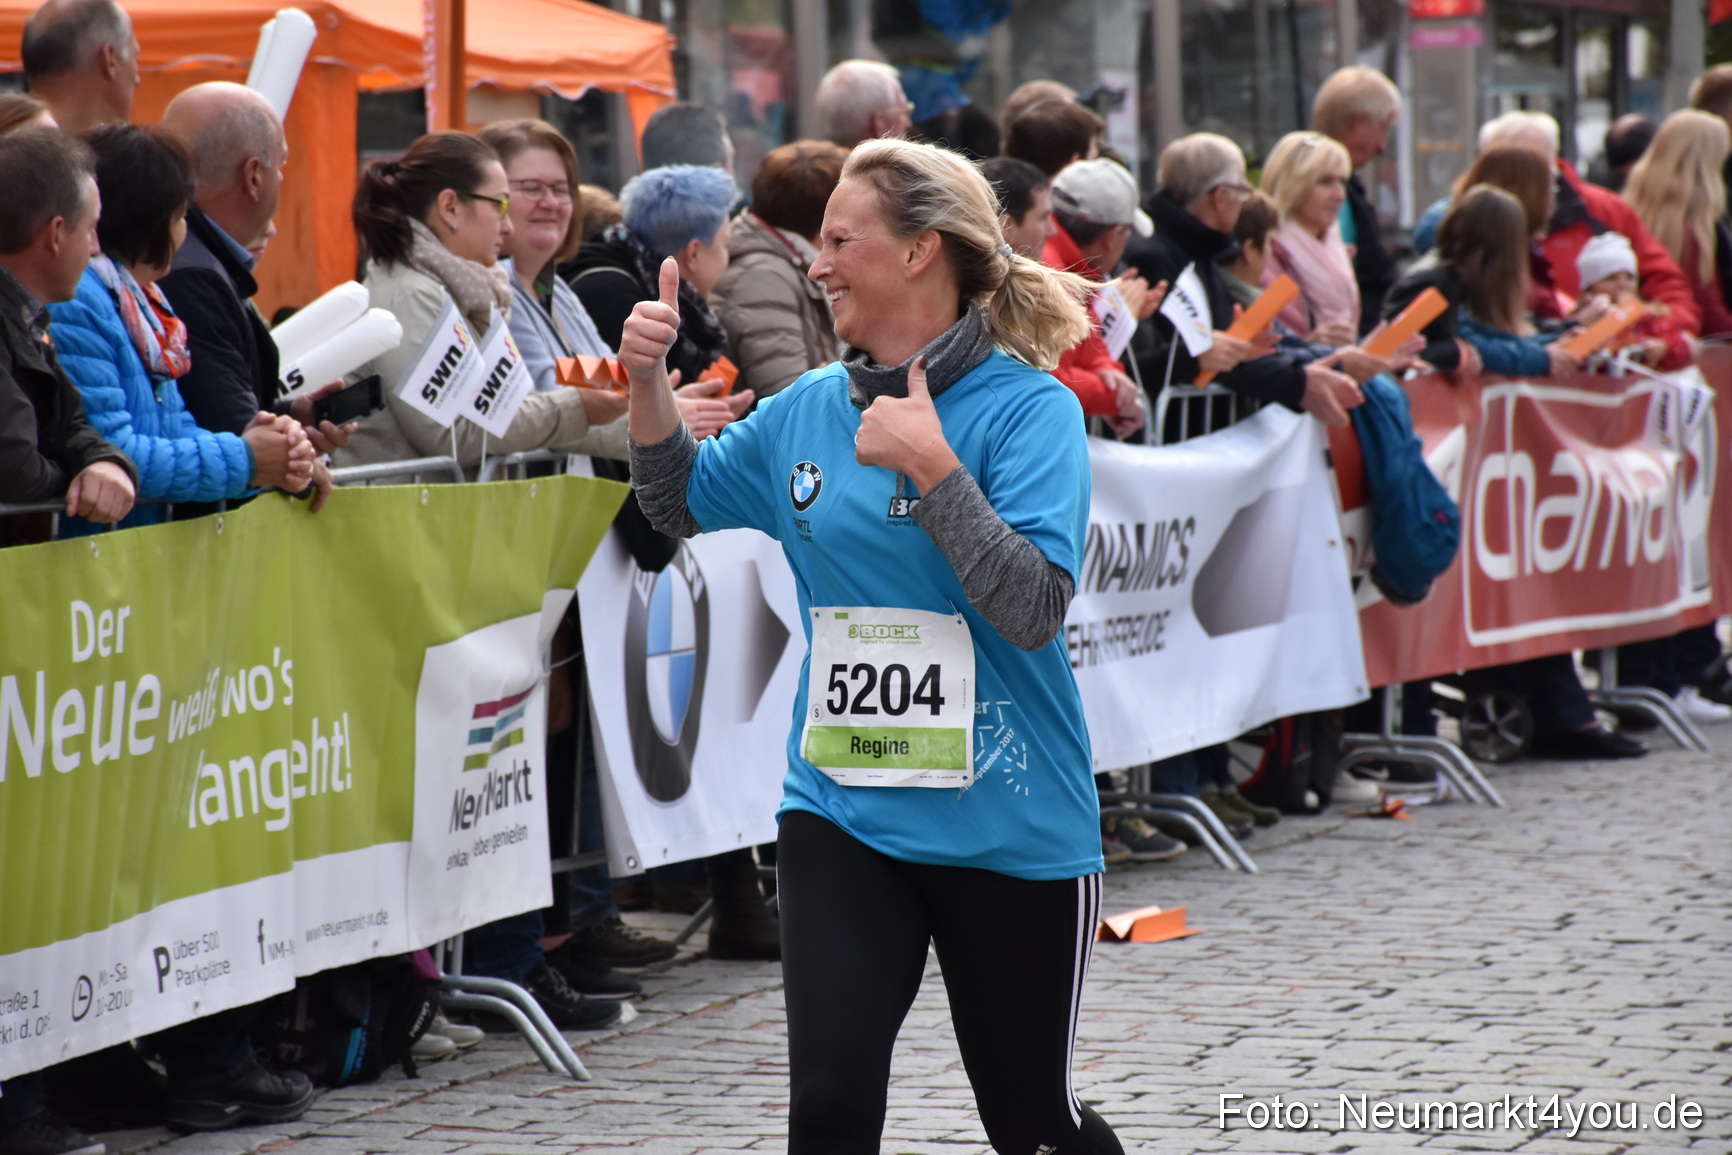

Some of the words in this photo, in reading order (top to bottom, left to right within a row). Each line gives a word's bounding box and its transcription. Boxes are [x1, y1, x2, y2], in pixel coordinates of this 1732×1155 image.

[421, 344, 464, 405] swn
[473, 356, 514, 416] swn
[792, 462, 822, 483] BMW
[70, 600, 131, 662] Der
[859, 624, 920, 640] BOCK
[826, 663, 945, 716] 5204
[814, 708, 821, 719] S
[0, 669, 162, 783] Neue
[850, 737, 910, 759] Regine
[999, 727, 1016, 749] 2017
[173, 940, 200, 960] über
[153, 946, 171, 994] P
[32, 989, 40, 1009] 1
